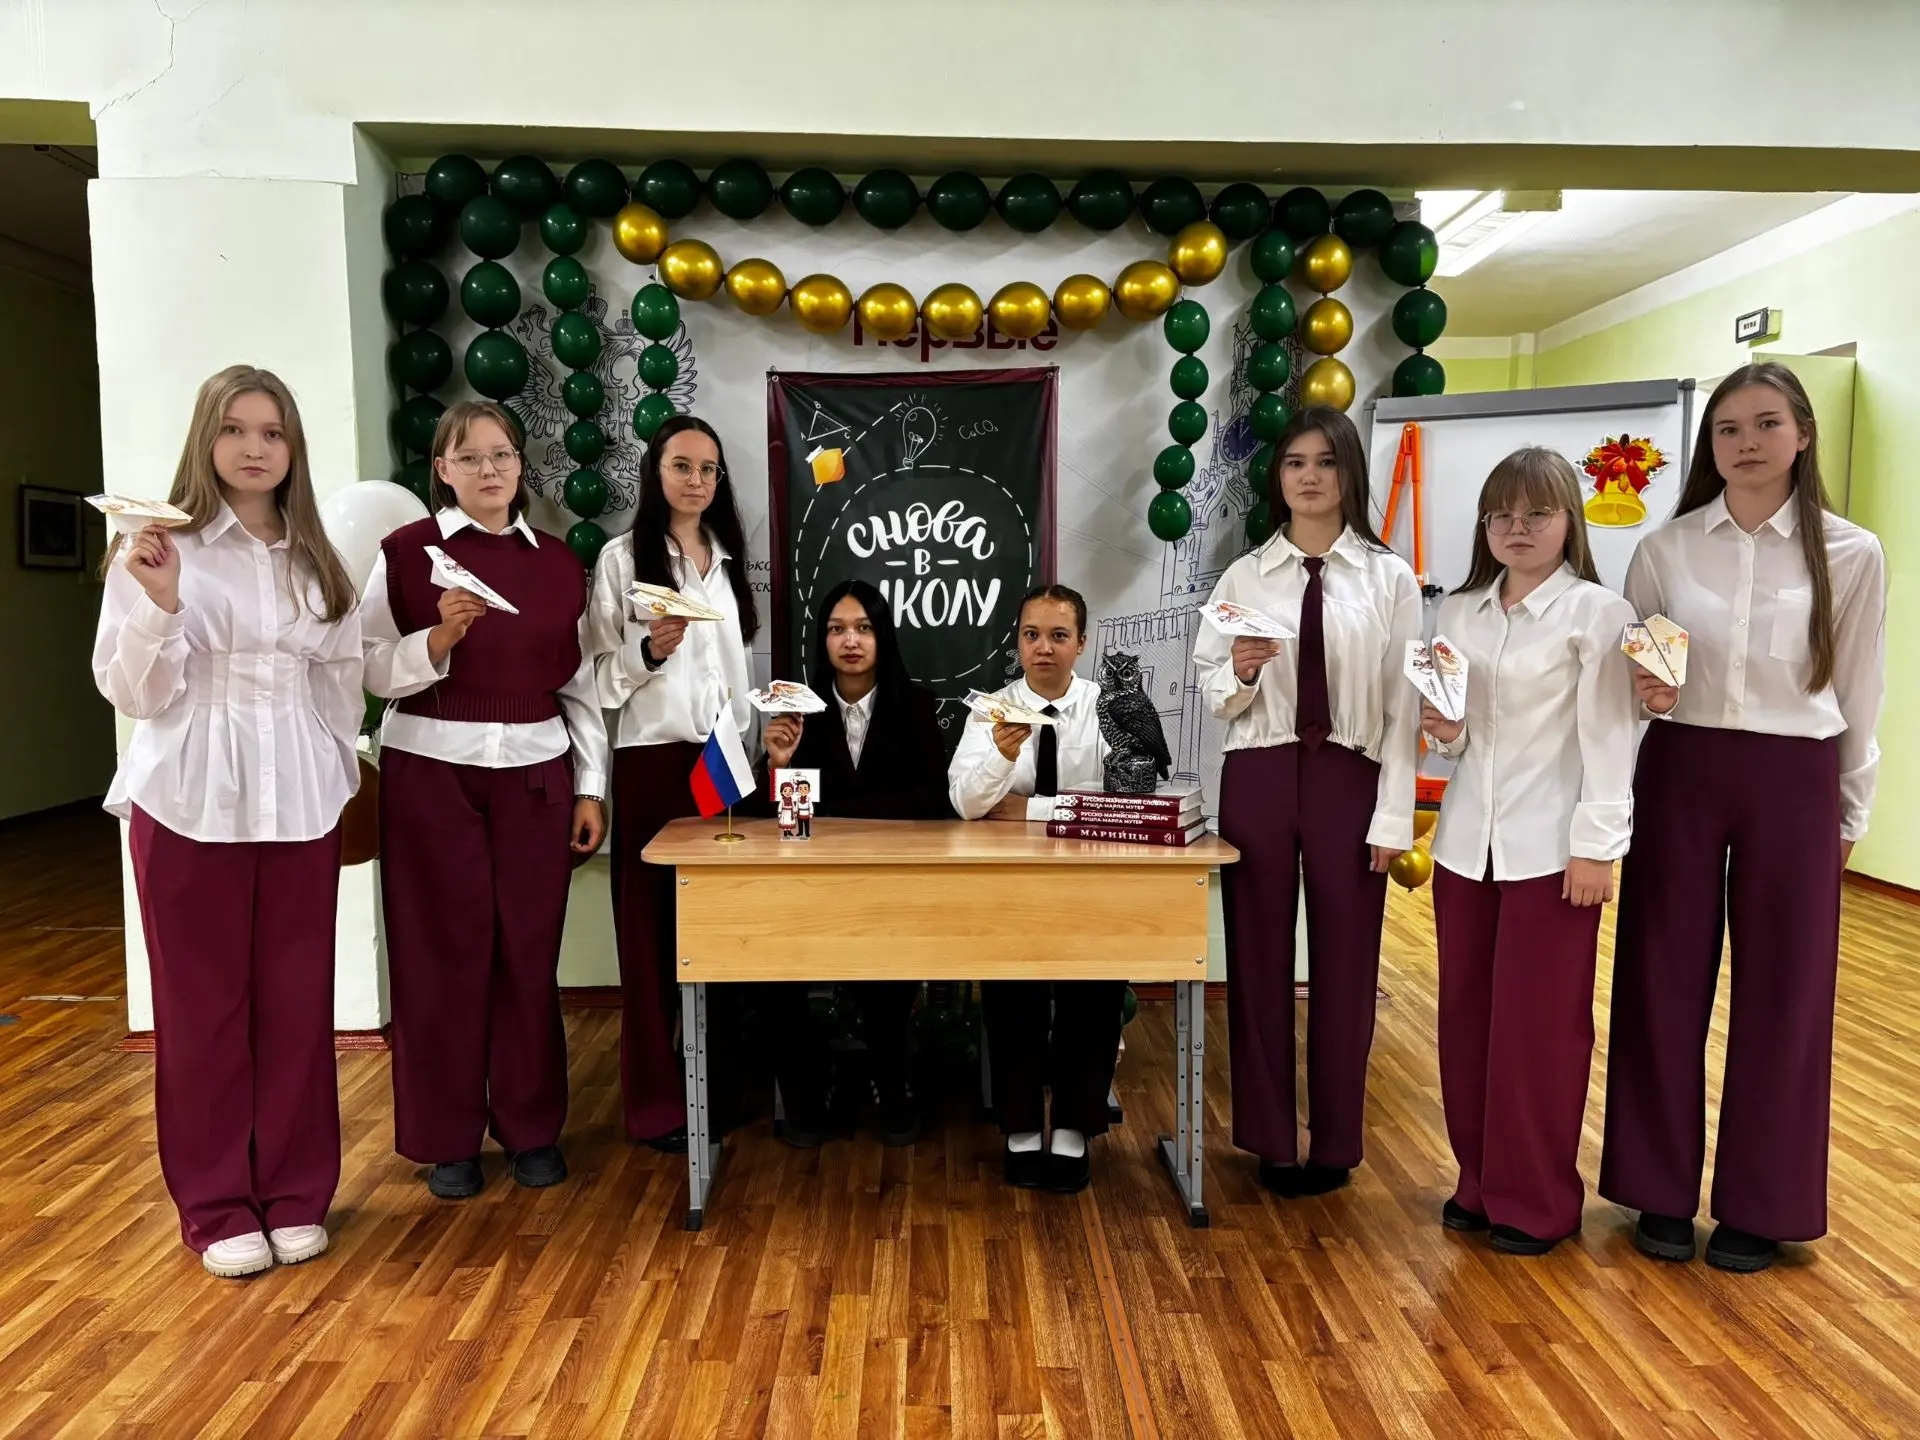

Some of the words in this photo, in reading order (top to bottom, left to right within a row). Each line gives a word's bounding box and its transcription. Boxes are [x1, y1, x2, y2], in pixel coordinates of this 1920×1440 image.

[879, 578, 1001, 628] КОЛУ
[1081, 811, 1140, 819] РУССКО-МАРИЙСКИЙ
[1080, 829, 1149, 841] МАРИЙЦЫ
